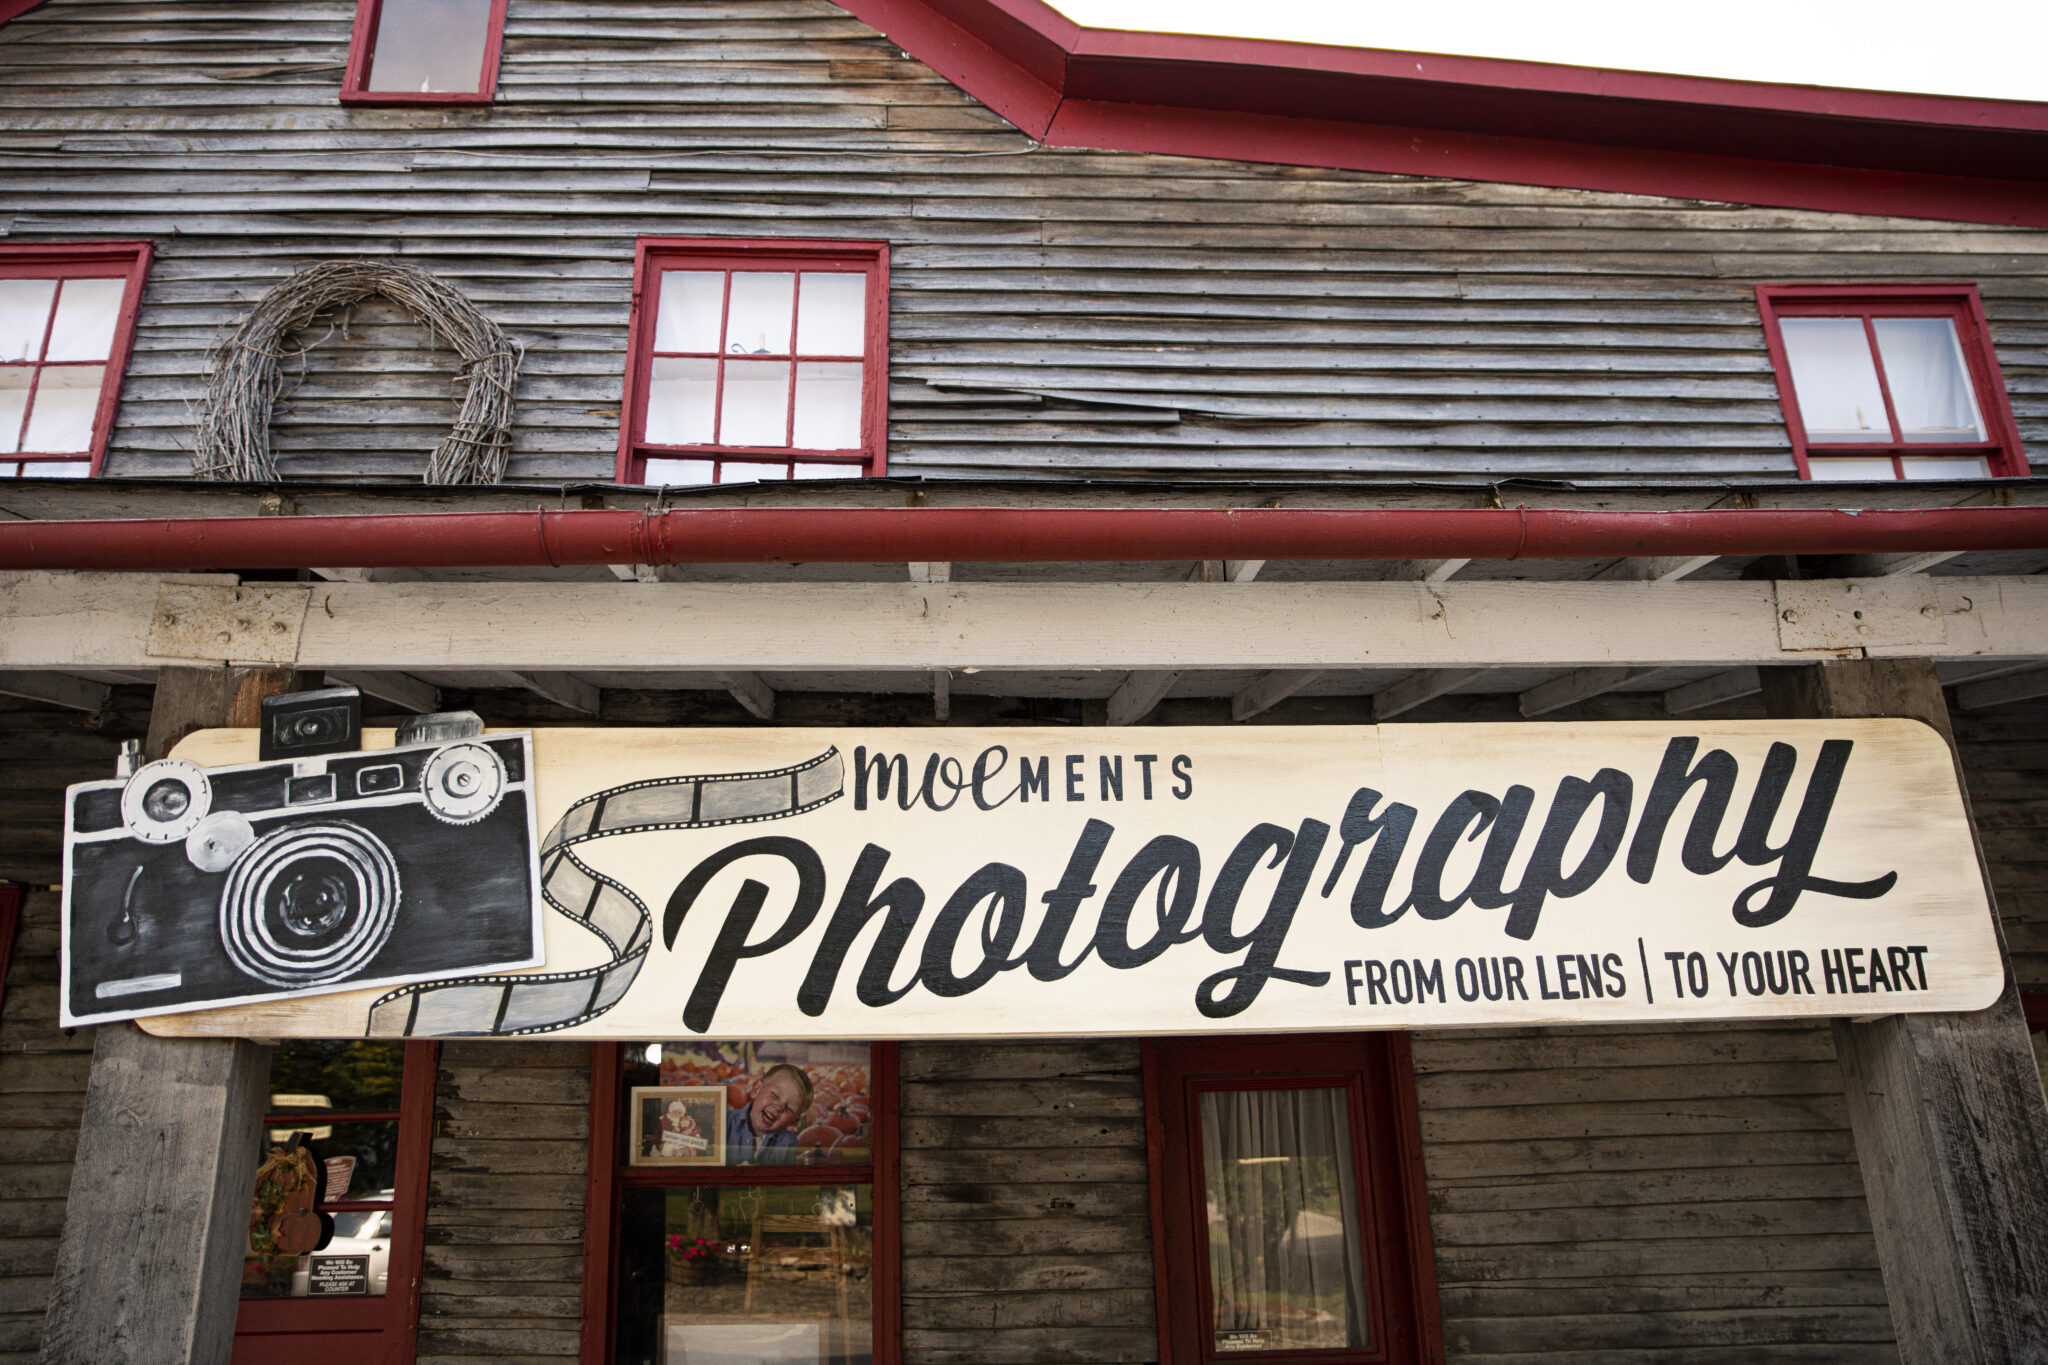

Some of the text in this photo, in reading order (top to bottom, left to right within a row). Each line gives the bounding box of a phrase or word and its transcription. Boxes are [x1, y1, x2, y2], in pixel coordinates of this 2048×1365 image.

[663, 736, 1897, 1032] Photography
[1344, 946, 1928, 1005] FROM OUR LENS TO YOUR HEART
